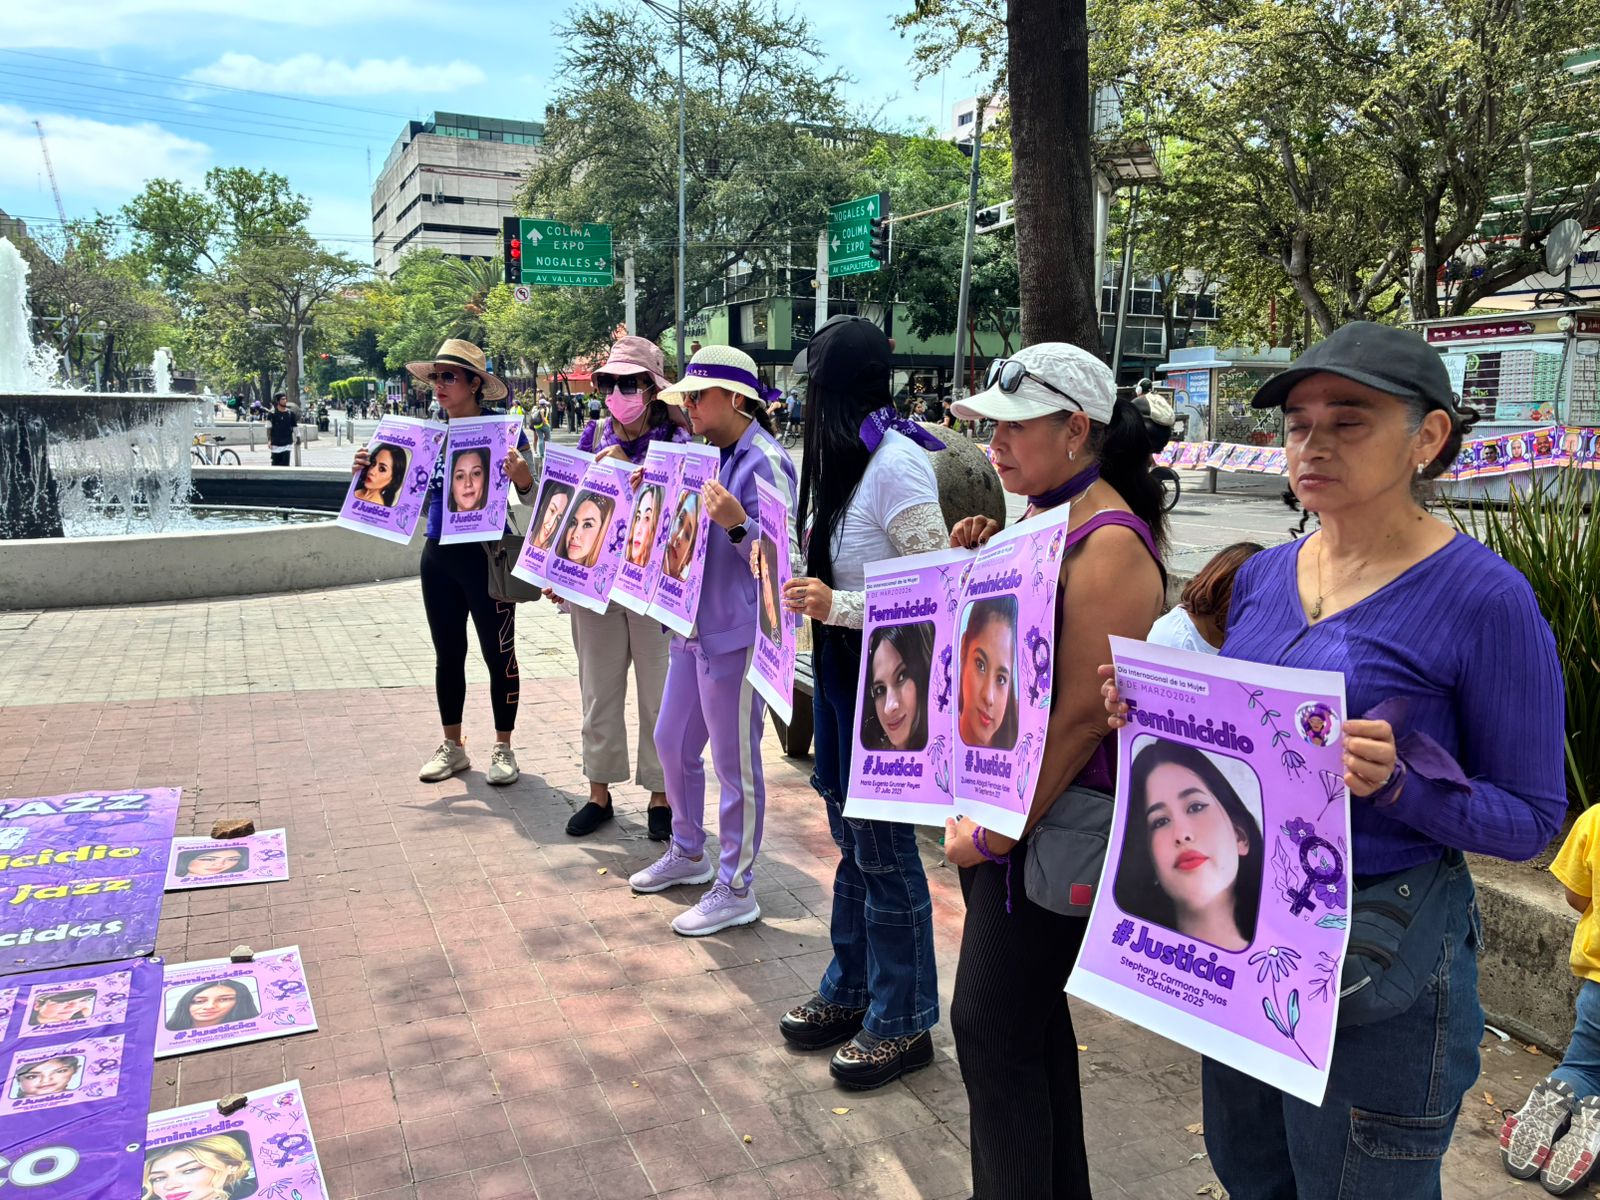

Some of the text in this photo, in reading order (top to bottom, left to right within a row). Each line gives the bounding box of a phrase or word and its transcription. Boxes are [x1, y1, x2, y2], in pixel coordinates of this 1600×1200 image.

[833, 206, 865, 222] NOGALES
[547, 226, 591, 238] COLIMA
[842, 225, 868, 239] COLIMA
[554, 241, 584, 250] EXPO
[846, 240, 864, 253] EXPO
[536, 257, 590, 268] NOGALES
[840, 260, 874, 272] CHAPULTEPEC
[552, 275, 599, 284] VALLARTA
[374, 432, 416, 447] Feminicidio
[450, 436, 492, 448] Feminicidio
[545, 466, 579, 485] Feminicidio
[582, 477, 619, 497] Feminicidio
[352, 501, 390, 518] #Justicia
[450, 512, 483, 524] #Justicia
[552, 558, 589, 580] #Justicia
[965, 568, 1022, 597] Feminicidio
[869, 597, 937, 622] Feminicidio
[1128, 669, 1168, 684] Internacional
[1169, 678, 1178, 686] de
[1179, 679, 1186, 687] la
[1187, 682, 1206, 693] Mujer
[1126, 681, 1137, 690] DE
[1140, 684, 1196, 704] MARZO2026
[1125, 697, 1254, 754] Feminicidio
[863, 755, 923, 777] #Justicia
[965, 750, 1012, 779] #Justicia
[1111, 918, 1236, 990] #Justicia
[1120, 956, 1228, 1007] Stephany Carmona Rojas
[1136, 973, 1205, 1008] 15 Octubre 2025
[174, 1021, 256, 1040] #Justicia
[12, 1092, 74, 1107] #Justicia
